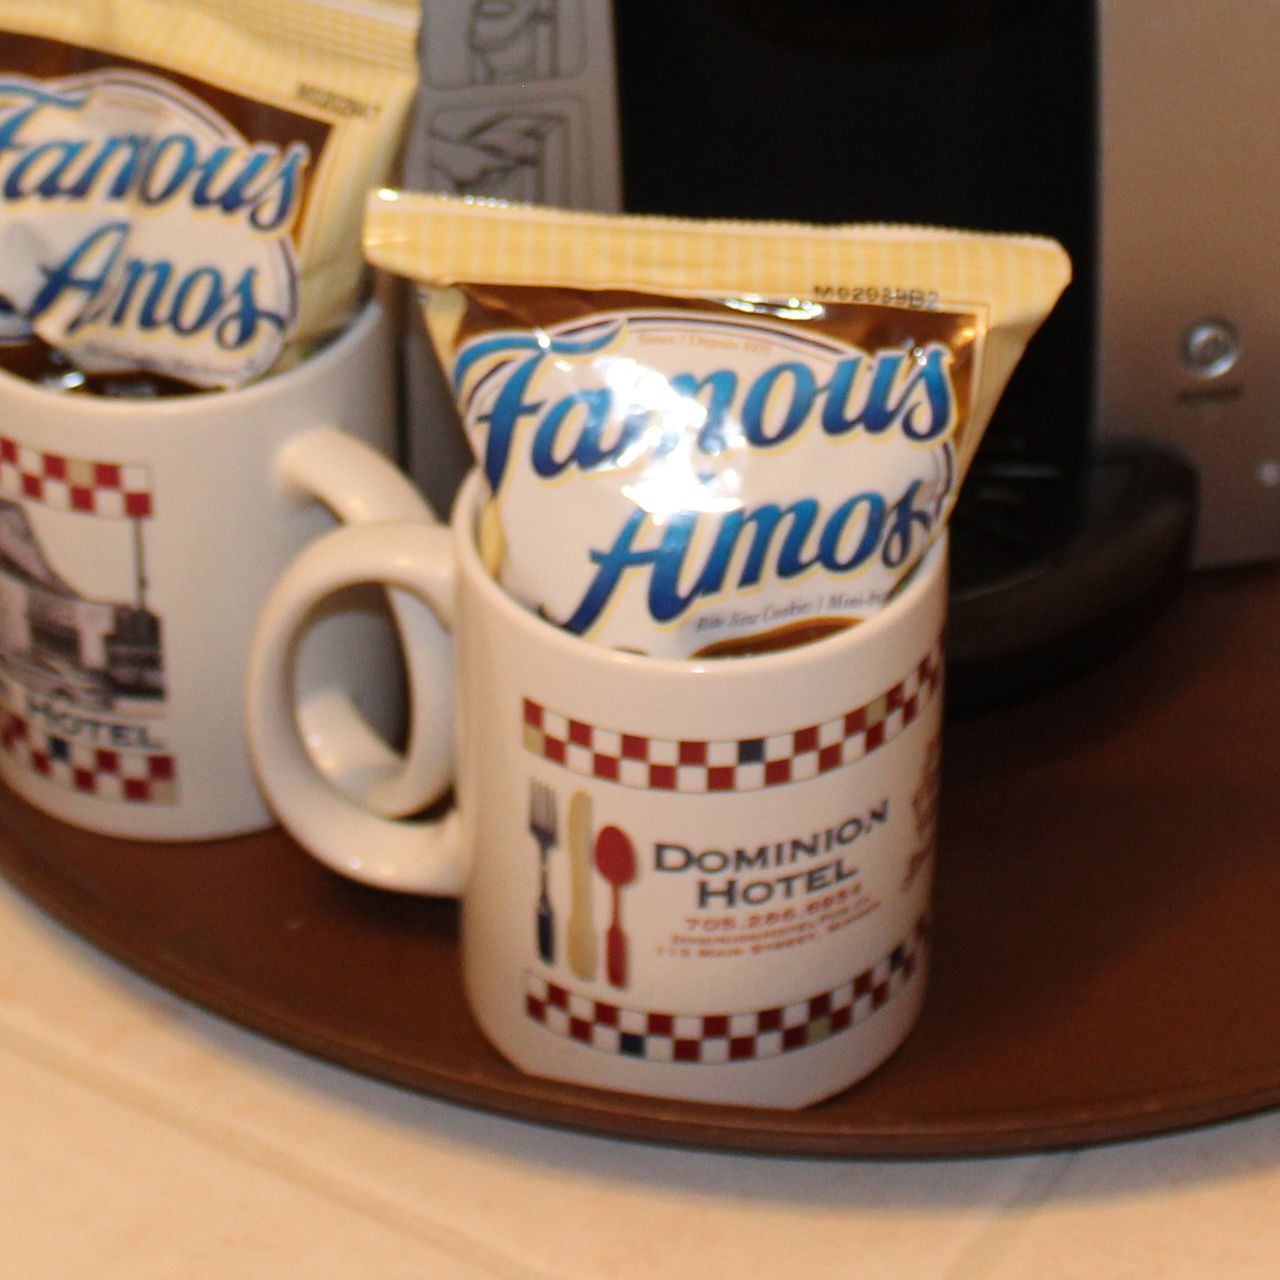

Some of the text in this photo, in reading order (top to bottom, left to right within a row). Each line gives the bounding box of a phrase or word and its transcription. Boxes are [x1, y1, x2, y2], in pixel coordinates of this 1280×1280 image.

[454, 329, 956, 496] Famous
[560, 478, 934, 635] Amos
[653, 798, 889, 874] DOMINION
[696, 858, 859, 910] HOTEL
